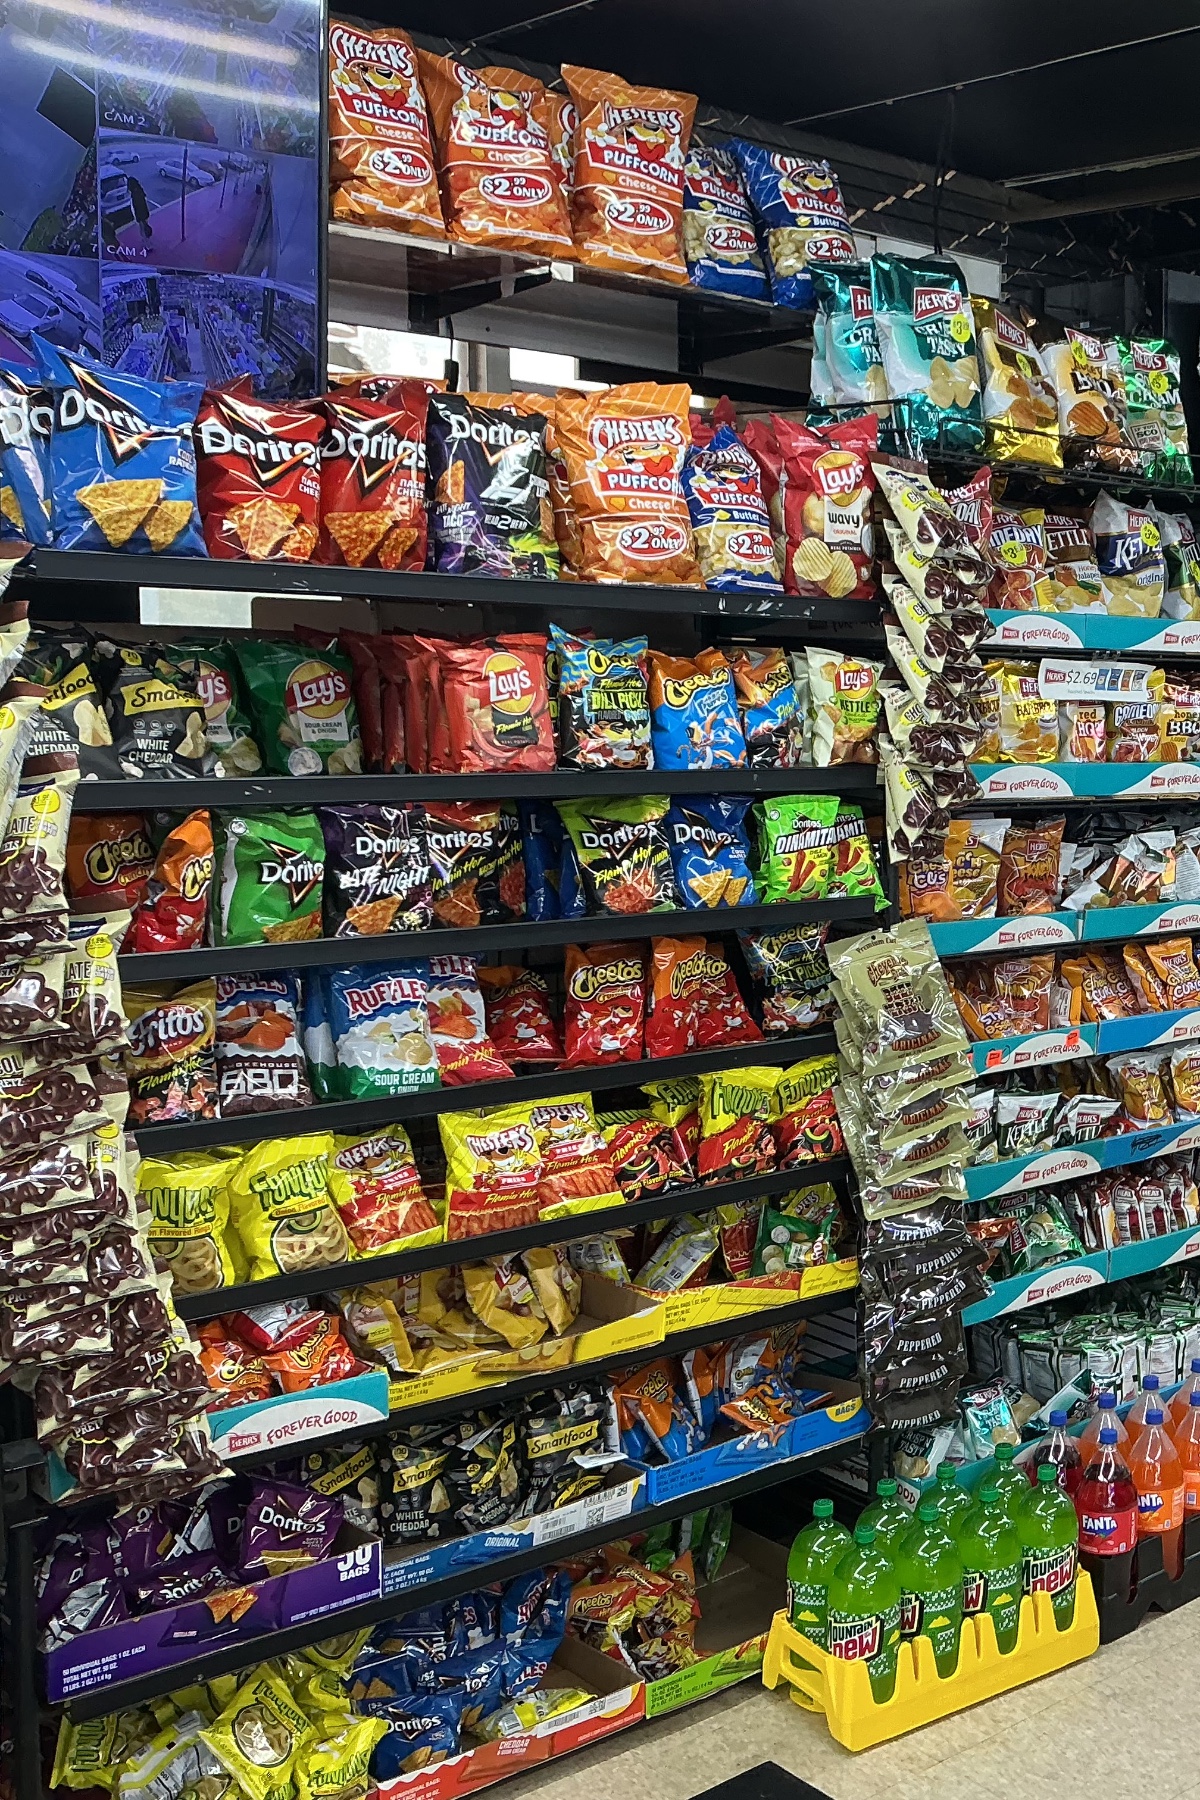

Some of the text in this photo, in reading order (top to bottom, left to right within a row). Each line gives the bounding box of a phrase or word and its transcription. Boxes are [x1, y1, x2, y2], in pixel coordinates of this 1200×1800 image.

[329, 25, 413, 78] CHESTER'S
[104, 110, 134, 125] CAM
[351, 97, 424, 132] PUFFCORN
[605, 102, 684, 135] CHESTER'S
[374, 124, 415, 140] Cheese
[401, 164, 430, 180] ONLY
[603, 150, 679, 185] PUFFCORN
[513, 187, 546, 200] ONLY
[618, 174, 657, 195] Cheese
[636, 214, 669, 231] ONLY
[106, 244, 148, 257] CAM 4
[450, 413, 541, 447] Doritos
[594, 417, 683, 446] CHESTER'S
[322, 427, 427, 469] Doritos
[607, 473, 684, 496] PUFFCORN
[816, 461, 865, 495] Lay's
[628, 497, 670, 511] Cheese
[827, 512, 861, 532] wavy
[650, 535, 681, 551] ONLY
[488, 666, 535, 703] Lay's
[838, 668, 872, 691] Lay's
[1066, 668, 1098, 685] $2.69
[293, 670, 347, 709] Lay's
[839, 700, 876, 714] KETTLE
[1078, 709, 1097, 720] red
[33, 729, 71, 743] WHITE
[136, 738, 170, 752] WHITE
[27, 743, 80, 757] CHEDDAR
[128, 751, 174, 765] CHEDDAR
[582, 820, 659, 848] Doritos
[791, 818, 822, 830] Doritos
[356, 835, 421, 858] Doritos
[775, 828, 836, 854] DINAMITA
[855, 937, 885, 955] Premium
[571, 960, 644, 1001] Cheetos
[346, 978, 429, 1017] RUFFLES
[127, 1006, 205, 1056] Fritos
[891, 1029, 942, 1052] ORIGINAL
[220, 1069, 299, 1097] BBQ
[374, 1071, 435, 1087] SOUR CREAM
[466, 1125, 534, 1152] CHESTER'S
[891, 1222, 945, 1241] PEPPERED
[914, 1247, 964, 1275] PEPPERED
[920, 1281, 968, 1311] PEPPERED
[897, 1331, 942, 1351] PEPPERED
[899, 1364, 949, 1388] PEPPERED
[834, 1402, 857, 1418] BAGS
[891, 1409, 941, 1429] PEPPERED
[267, 1409, 359, 1445] FOREVER GOOD
[529, 1427, 595, 1456] Smartfood
[318, 1452, 374, 1494] Smartfood
[479, 1496, 501, 1514] WHITE
[258, 1505, 327, 1534] Doritos
[389, 1519, 430, 1532] CHEDDAR
[395, 1510, 425, 1523] WHITE
[1082, 1513, 1118, 1531] FANTA
[484, 1535, 520, 1549] ORIGINAL
[339, 1563, 371, 1582] BAGS
[574, 1594, 613, 1612] Cheetos
